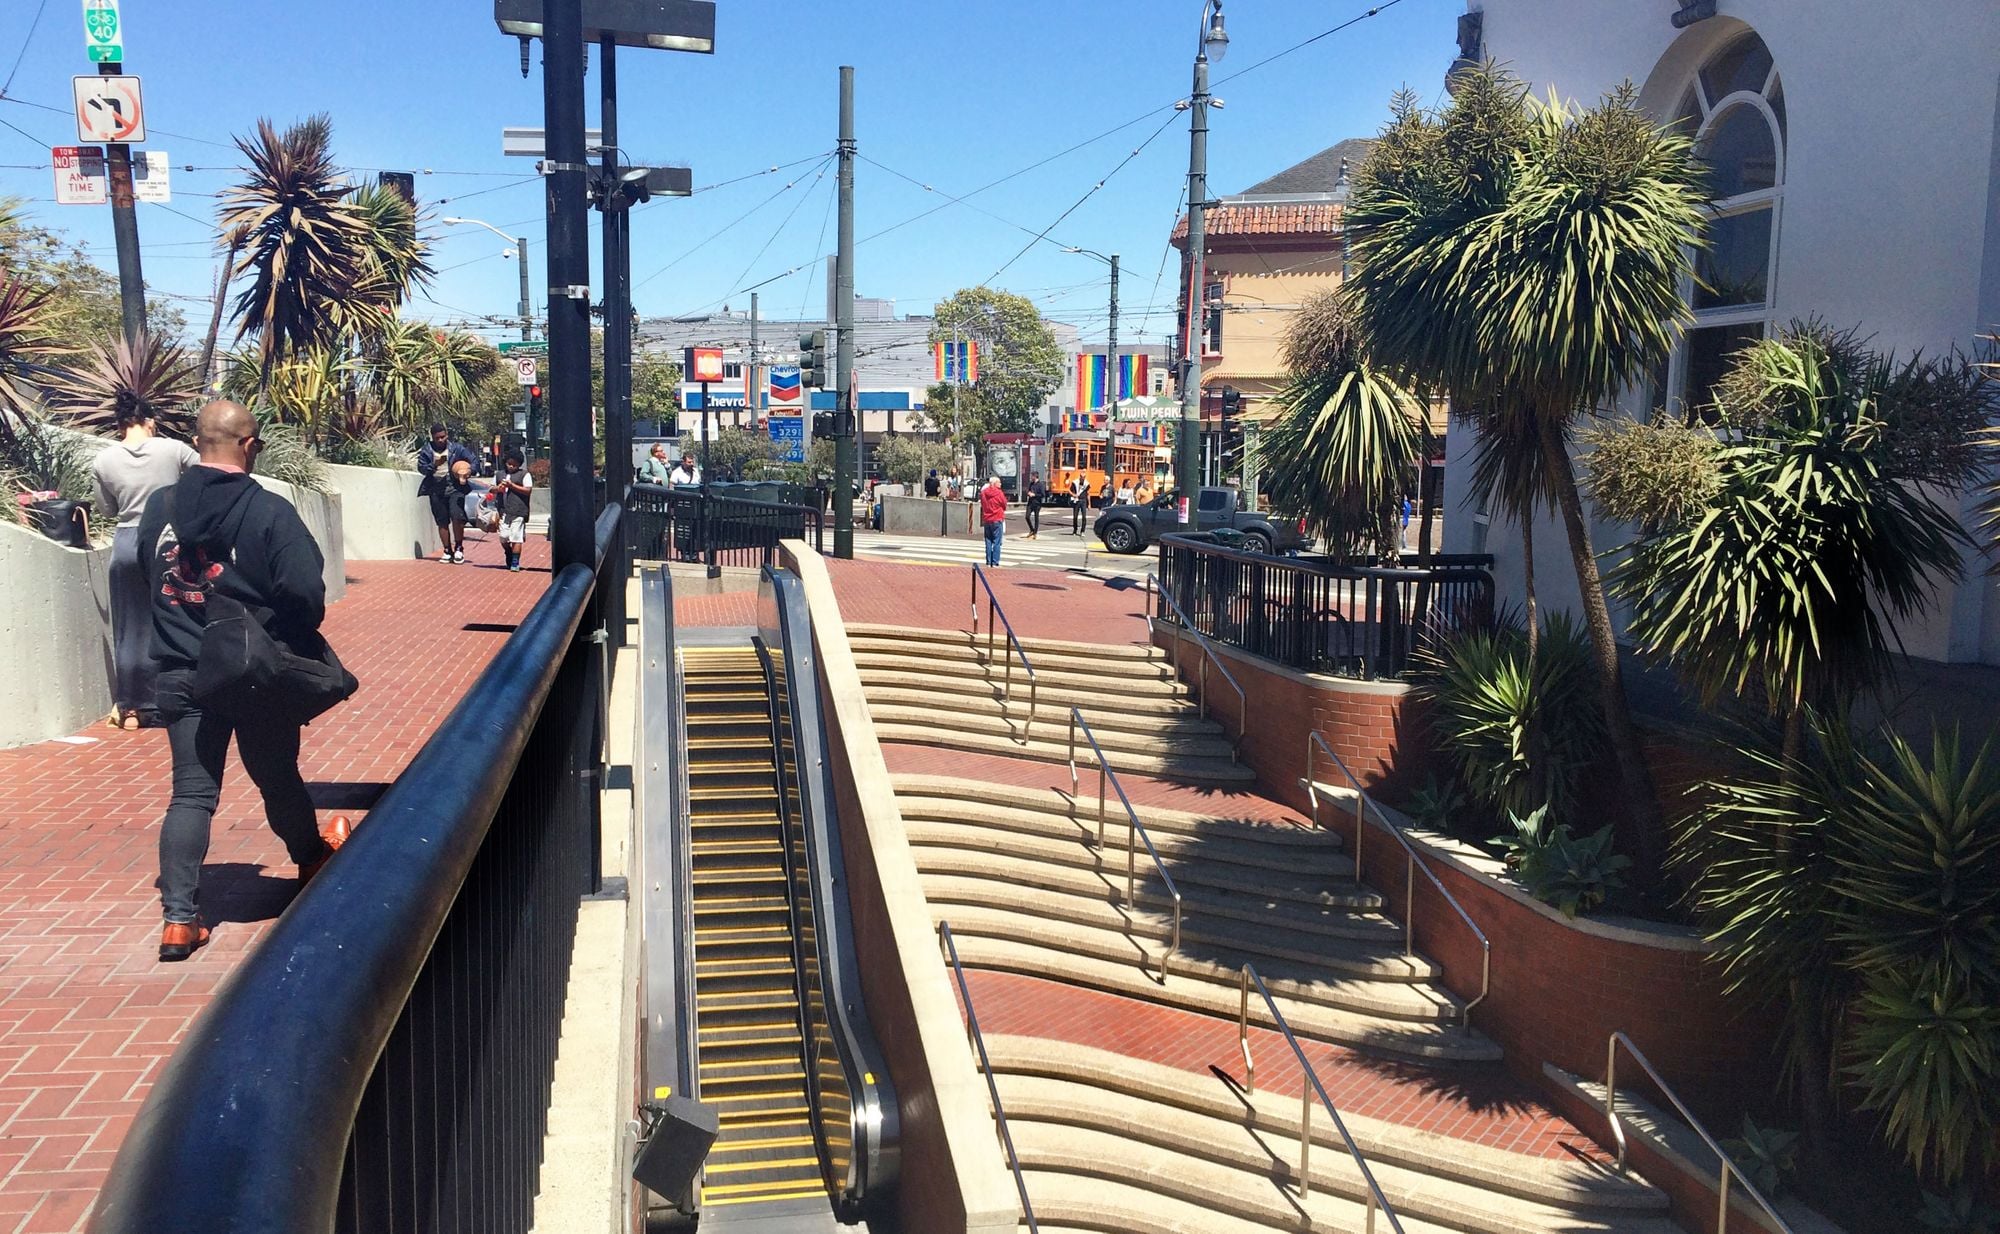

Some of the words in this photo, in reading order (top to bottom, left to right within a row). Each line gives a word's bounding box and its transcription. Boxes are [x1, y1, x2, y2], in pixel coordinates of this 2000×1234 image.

[94, 26, 113, 38] 40
[54, 156, 69, 168] NO
[70, 173, 89, 181] ANY
[68, 183, 94, 192] TIME
[770, 365, 801, 373] Chevron
[707, 395, 753, 407] hevro
[1120, 407, 1148, 418] TWIN
